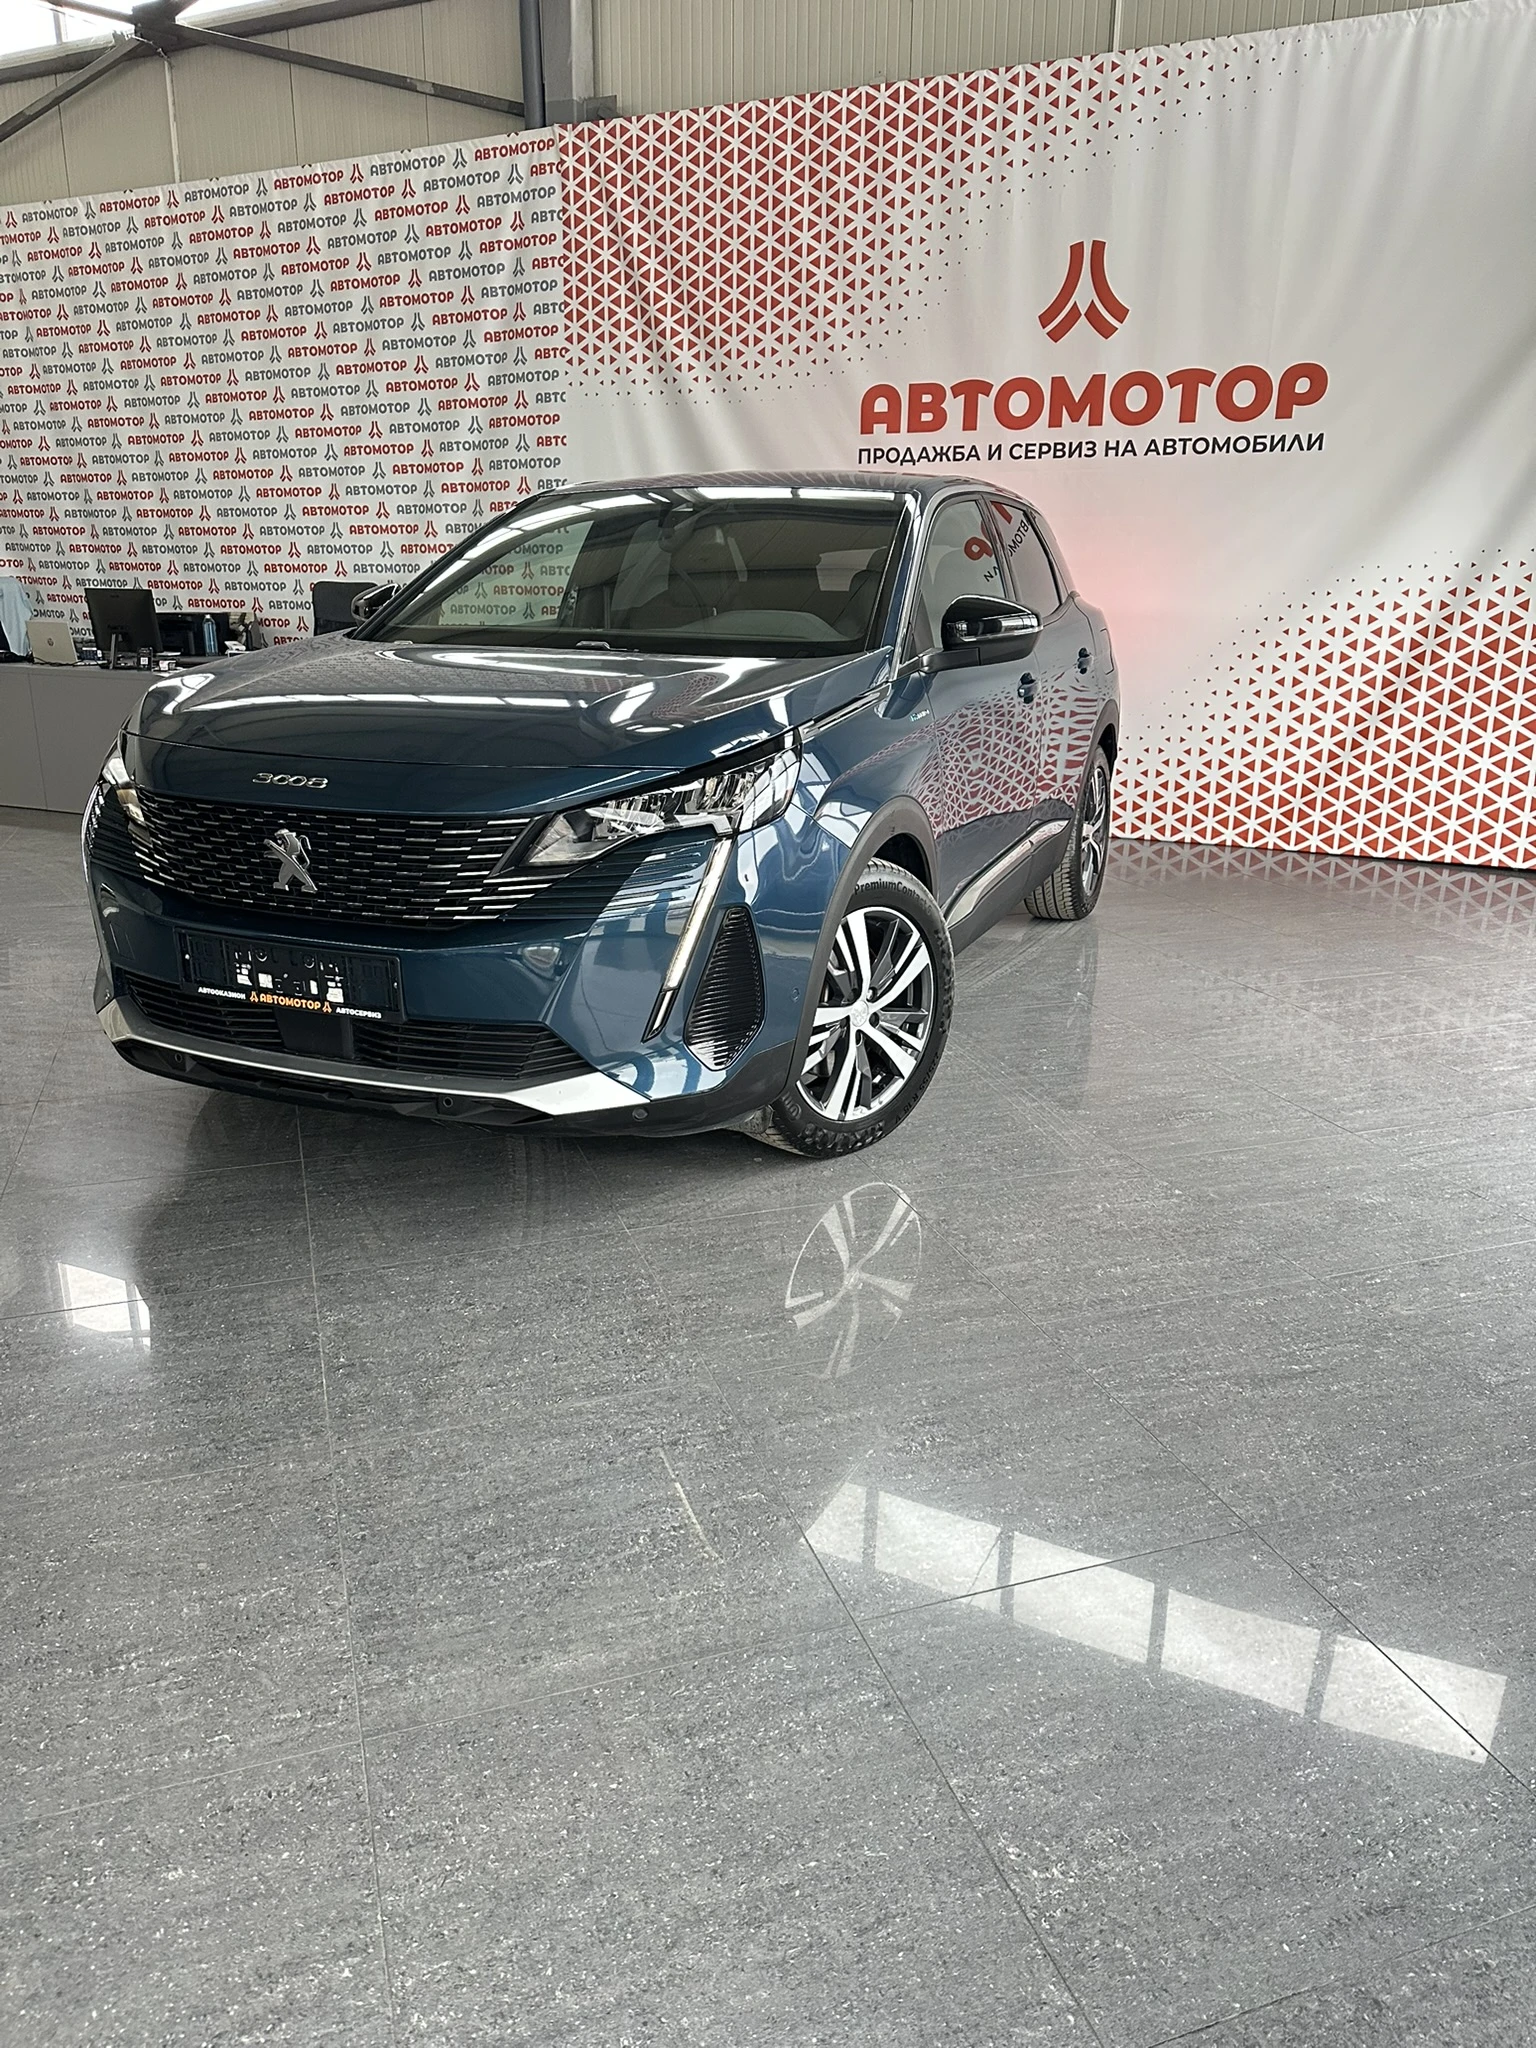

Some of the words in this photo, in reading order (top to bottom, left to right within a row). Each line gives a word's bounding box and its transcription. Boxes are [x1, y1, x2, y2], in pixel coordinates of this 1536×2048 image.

[22, 206, 78, 223] АВТОМОТОР
[99, 195, 160, 213] АВТОМОТОР
[184, 183, 249, 202] АВТОМОТОР
[274, 170, 344, 190] АВТОМОТОР
[370, 155, 445, 176] АВТОМОТОР
[474, 136, 556, 162] АВТОМОТОР
[63, 221, 121, 238] АВТОМОТОР
[144, 210, 206, 229] АВТОМОТОР
[229, 199, 298, 217] АВТОМОТОР
[324, 185, 395, 206] АВТОМОТОР
[423, 170, 500, 192] АВТОМОТОР
[27, 246, 82, 262] АВТОМОТОР
[105, 236, 164, 254] АВТОМОТОР
[189, 226, 254, 244] АВТОМОТОР
[278, 214, 346, 233] АВТОМОТОР
[375, 201, 448, 221] АВТОМОТОР
[477, 184, 556, 208] АВТОМОТОР
[68, 261, 125, 277] АВТОМОТОР
[148, 252, 209, 269] АВТОМОТОР
[233, 242, 300, 259] АВТОМОТОР
[327, 229, 397, 249] АВТОМОТОР
[426, 217, 502, 237] АВТОМОТОР
[32, 285, 87, 300] АВТОМОТОР
[111, 277, 168, 293] АВТОМОТОР
[193, 268, 257, 285] АВТОМОТОР
[281, 257, 349, 275] АВТОМОТОР
[378, 246, 451, 265] АВТОМОТОР
[479, 233, 557, 254] АВТОМОТОР
[73, 301, 129, 316] АВТОМОТОР
[152, 293, 213, 309] АВТОМОТОР
[237, 284, 303, 301] АВТОМОТОР
[330, 274, 400, 292] АВТОМОТОР
[429, 263, 505, 282] АВТОМОТОР
[36, 324, 91, 338] АВТОМОТОР
[116, 317, 172, 332] АВТОМОТОР
[197, 309, 261, 325] АВТОМОТОР
[285, 300, 353, 317] АВТОМОТОР
[379, 291, 454, 308] АВТОМОТОР
[481, 279, 558, 299] АВТОМОТОР
[2, 346, 57, 359] АВТОМОТОР
[78, 340, 134, 354] АВТОМОТОР
[156, 333, 217, 348] АВТОМОТОР
[241, 326, 307, 341] АВТОМОТОР
[333, 317, 404, 334] АВТОМОТОР
[432, 308, 508, 325] АВТОМОТОР
[42, 362, 96, 375] АВТОМОТОР
[120, 356, 177, 370] АВТОМОТОР
[201, 350, 264, 365] АВТОМОТОР
[288, 343, 358, 358] АВТОМОТОР
[382, 335, 456, 351] АВТОМОТОР
[484, 325, 559, 343] АВТОМОТОР
[7, 383, 61, 395] АВТОМОТОР
[83, 378, 139, 391] АВТОМОТОР
[160, 373, 221, 387] АВТОМОТОР
[245, 367, 311, 381] АВТОМОТОР
[336, 360, 407, 375] АВТОМОТОР
[435, 352, 508, 368] АВТОМОТОР
[49, 399, 102, 412] АВТОМОТОР
[124, 395, 180, 408] АВТОМОТОР
[205, 390, 267, 404] АВТОМОТОР
[291, 384, 360, 398] АВТОМОТОР
[386, 377, 458, 393] АВТОМОТОР
[488, 369, 559, 386] АВТОМОТОР
[13, 420, 66, 431] АВТОМОТОР
[87, 416, 144, 428] АВТОМОТОР
[164, 412, 225, 425] АВТОМОТОР
[249, 407, 314, 421] АВТОМОТОР
[340, 402, 410, 416] АВТОМОТОР
[438, 395, 508, 411] АВТОМОТОР
[859, 362, 1328, 435] АВТОМОТОР
[55, 436, 107, 448] АВТОМОТОР
[128, 433, 185, 445] АВТОМОТОР
[209, 430, 270, 442] АВТОМОТОР
[295, 425, 362, 439] АВТОМОТОР
[389, 420, 460, 434] АВТОМОТОР
[489, 414, 560, 429] АВТОМОТОР
[20, 456, 73, 466] АВТОМОТОР
[92, 454, 149, 464] АВТОМОТОР
[169, 451, 229, 462] АВТОМОТОР
[253, 447, 317, 460] АВТОМОТОР
[344, 443, 414, 456] АВТОМОТОР
[439, 438, 509, 452] АВТОМОТОР
[858, 443, 981, 466] ПРОДАЖБА
[987, 442, 1002, 461] И
[1008, 440, 1098, 460] СЕРВИЗ
[1104, 438, 1139, 458] НА
[1145, 432, 1325, 457] АВТОМОБИЛИ
[60, 473, 112, 483] АВТОМОТОР
[131, 471, 189, 482] АВТОМОТОР
[213, 468, 274, 480] АВТОМОТОР
[298, 465, 365, 478] АВТОМОТОР
[392, 462, 464, 475] АВТОМОТОР
[489, 457, 561, 471] АВТОМОТОР
[27, 491, 80, 501] АВТОМОТОР
[97, 490, 154, 501] АВТОМОТОР
[173, 489, 233, 499] АВТОМОТОР
[256, 487, 322, 498] АВТОМОТОР
[345, 484, 417, 496] АВТОМОТОР
[441, 480, 510, 493] АВТОМОТОР
[64, 509, 117, 518] АВТОМОТОР
[136, 508, 193, 518] АВТОМОТОР
[217, 507, 277, 517] АВТОМОТОР
[302, 505, 369, 516] АВТОМОТОР
[397, 503, 467, 514] АВТОМОТОР
[32, 526, 86, 536] АВТОМОТОР
[103, 527, 157, 536] АВТОМОТОР
[178, 526, 237, 536] АВТОМОТОР
[260, 525, 325, 536] АВТОМОТОР
[349, 524, 419, 535] АВТОМОТОР
[5, 542, 51, 552] АВТОМОТОР
[69, 544, 122, 554] АВТОМОТОР
[142, 544, 198, 554] АВТОМОТОР
[220, 545, 282, 554] АВТОМОТОР
[307, 544, 373, 554] АВТОМОТОР
[39, 560, 90, 570] АВТОМОТОР
[109, 562, 161, 572] АВТОМОТОР
[183, 563, 241, 573] АВТОМОТОР
[264, 563, 328, 573] АВТОМОТОР
[353, 563, 420, 574] АВТОМОТОР
[75, 578, 128, 588] АВТОМОТОР
[147, 580, 203, 590] АВТОМОТОР
[224, 581, 286, 591] АВТОМОТОР
[188, 598, 246, 609] АВТОМОТОР
[450, 604, 516, 615] АВТОМОТОР
[252, 772, 328, 788] 3008
[259, 992, 321, 1010] АВТОМОТОР
